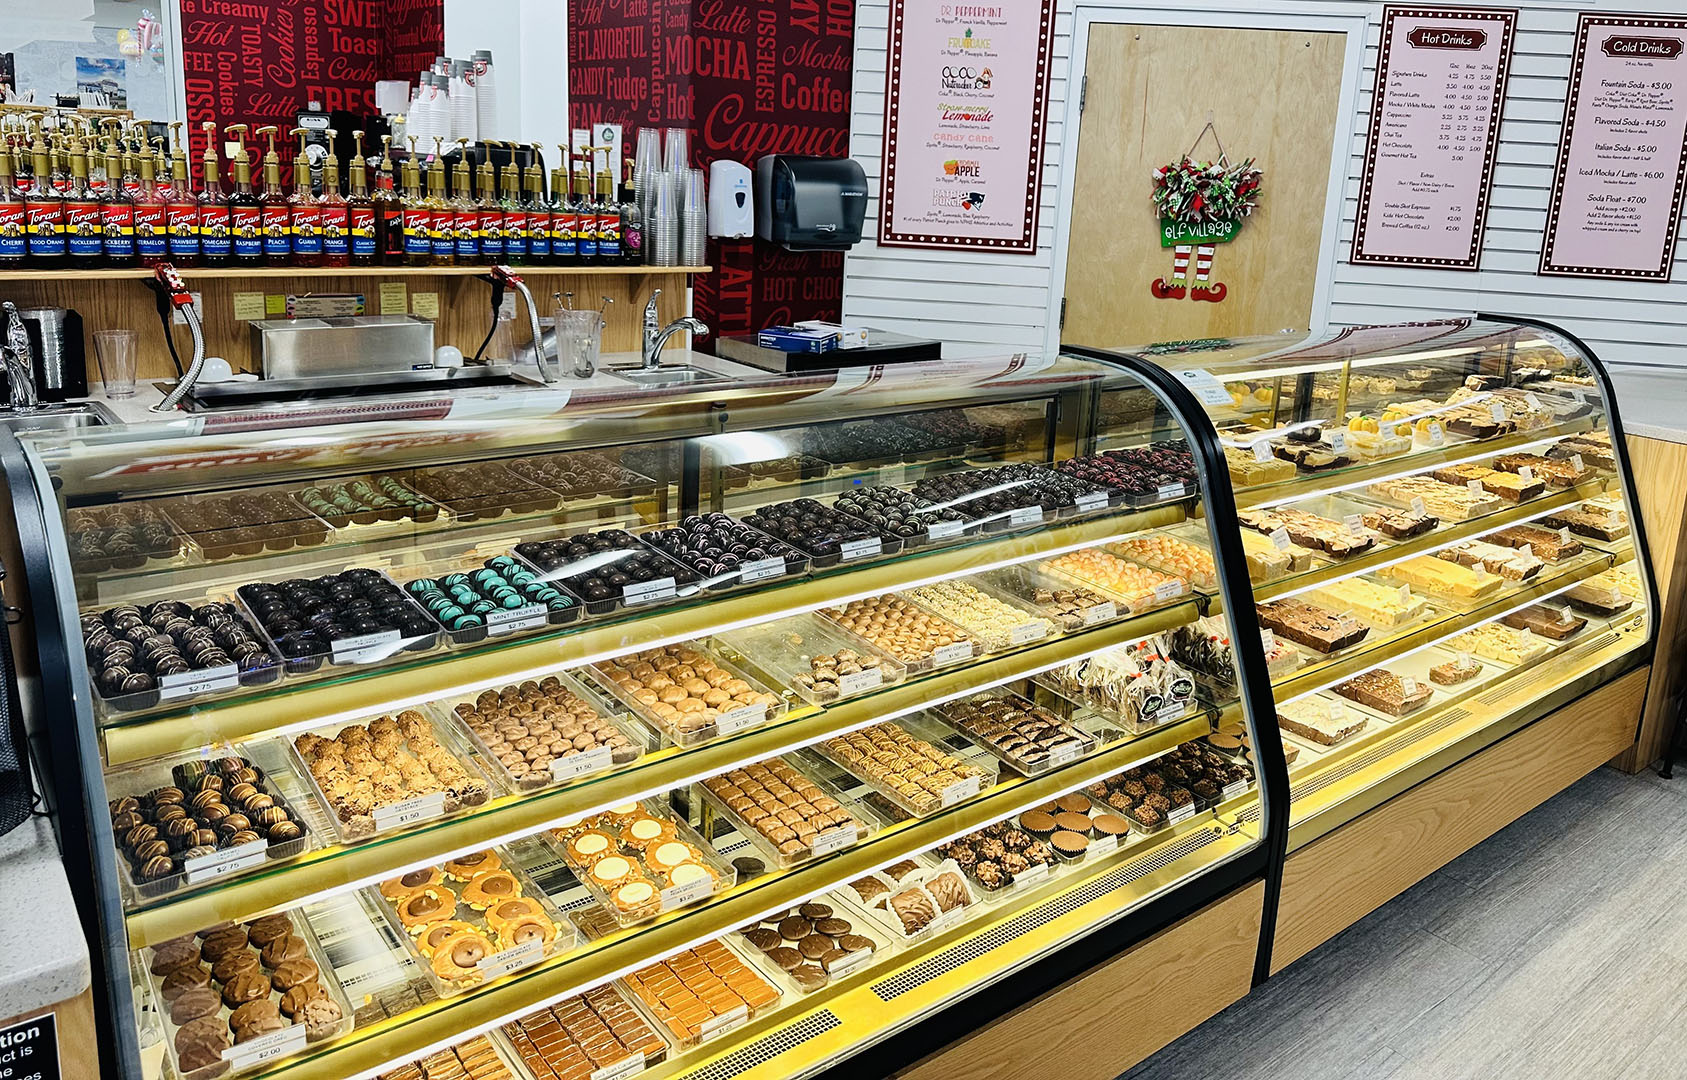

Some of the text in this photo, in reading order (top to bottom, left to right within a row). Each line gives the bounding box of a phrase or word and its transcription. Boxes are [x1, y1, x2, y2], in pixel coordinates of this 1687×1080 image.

[202, 0, 269, 25] Creamy
[665, 8, 688, 32] Candy
[693, 0, 751, 34] Latte
[183, 20, 235, 46] Hot
[1421, 32, 1472, 46] Hot Drinks
[267, 7, 296, 88] Cookies
[301, 7, 324, 80] Espresso
[578, 25, 648, 60] FLAVORFUL
[1613, 40, 1671, 54] Cold Drinks
[184, 51, 214, 72] FEE
[241, 24, 263, 88] TOASTY
[665, 34, 751, 80] MOCHA
[755, 10, 776, 112] ESPRESSO
[782, 39, 851, 71] Mocha
[217, 51, 239, 115] Cookies
[570, 67, 605, 95] CANDY
[607, 66, 647, 111] Fudge
[1627, 81, 1645, 89] Soda
[1651, 82, 1672, 90] $3.00
[243, 93, 299, 117] Latte
[306, 86, 377, 118] FRES
[667, 83, 695, 120] Hot
[1594, 116, 1622, 125] Flavored
[1622, 117, 1640, 126] Soda
[1595, 143, 1657, 153] Italian Soda $5.00
[955, 166, 980, 177] APPLE
[1579, 168, 1593, 176] Iced
[1594, 169, 1615, 177] Mocha
[1587, 194, 1604, 202] Soda
[1606, 195, 1621, 203] Float
[0, 208, 25, 223] orani
[28, 207, 61, 226] Torani
[67, 208, 99, 226] Torani
[101, 210, 129, 226] Torani
[134, 210, 161, 226] Torani
[168, 210, 197, 227] Torani
[203, 212, 230, 228] Torani
[233, 213, 261, 227] Torani
[262, 212, 288, 227] Torani
[292, 212, 319, 227] Torani
[321, 213, 346, 228] Torani
[355, 215, 375, 229] Tora
[433, 217, 453, 230] Tora
[454, 216, 478, 230] Torani
[504, 216, 526, 230] Torani
[527, 217, 550, 230] Torani
[1165, 221, 1233, 240] elf village
[203, 238, 230, 246] POMEGRAN
[763, 276, 841, 302] HOT CHOC
[0, 1026, 40, 1048] tion
[20, 1046, 33, 1057] is
[259, 1047, 281, 1058] $2.00
